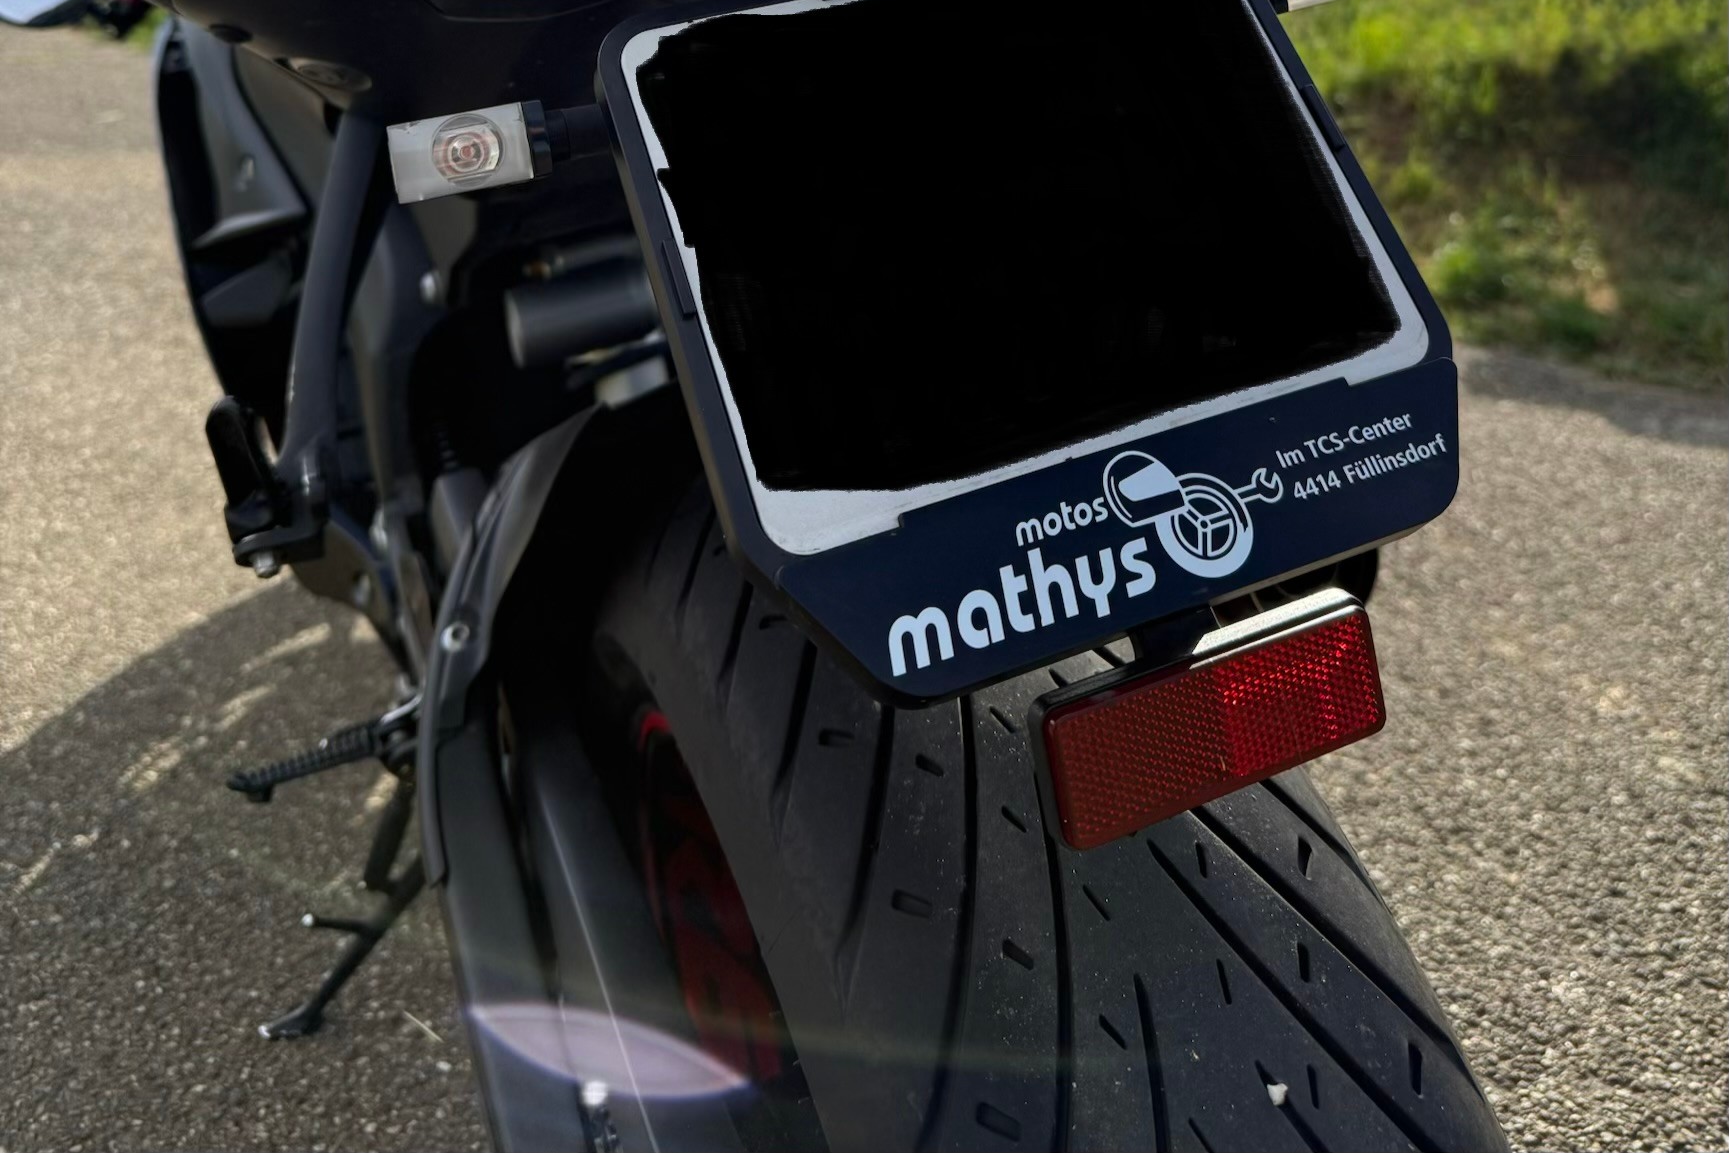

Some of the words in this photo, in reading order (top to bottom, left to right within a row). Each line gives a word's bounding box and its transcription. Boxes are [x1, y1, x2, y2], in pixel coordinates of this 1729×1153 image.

[1275, 449, 1306, 469] Im
[1303, 413, 1413, 459] TCS-Center
[1293, 470, 1342, 500] 4414
[1342, 432, 1448, 485] Füllinsdorf
[1015, 497, 1108, 547] motos
[888, 537, 1157, 677] mathys
